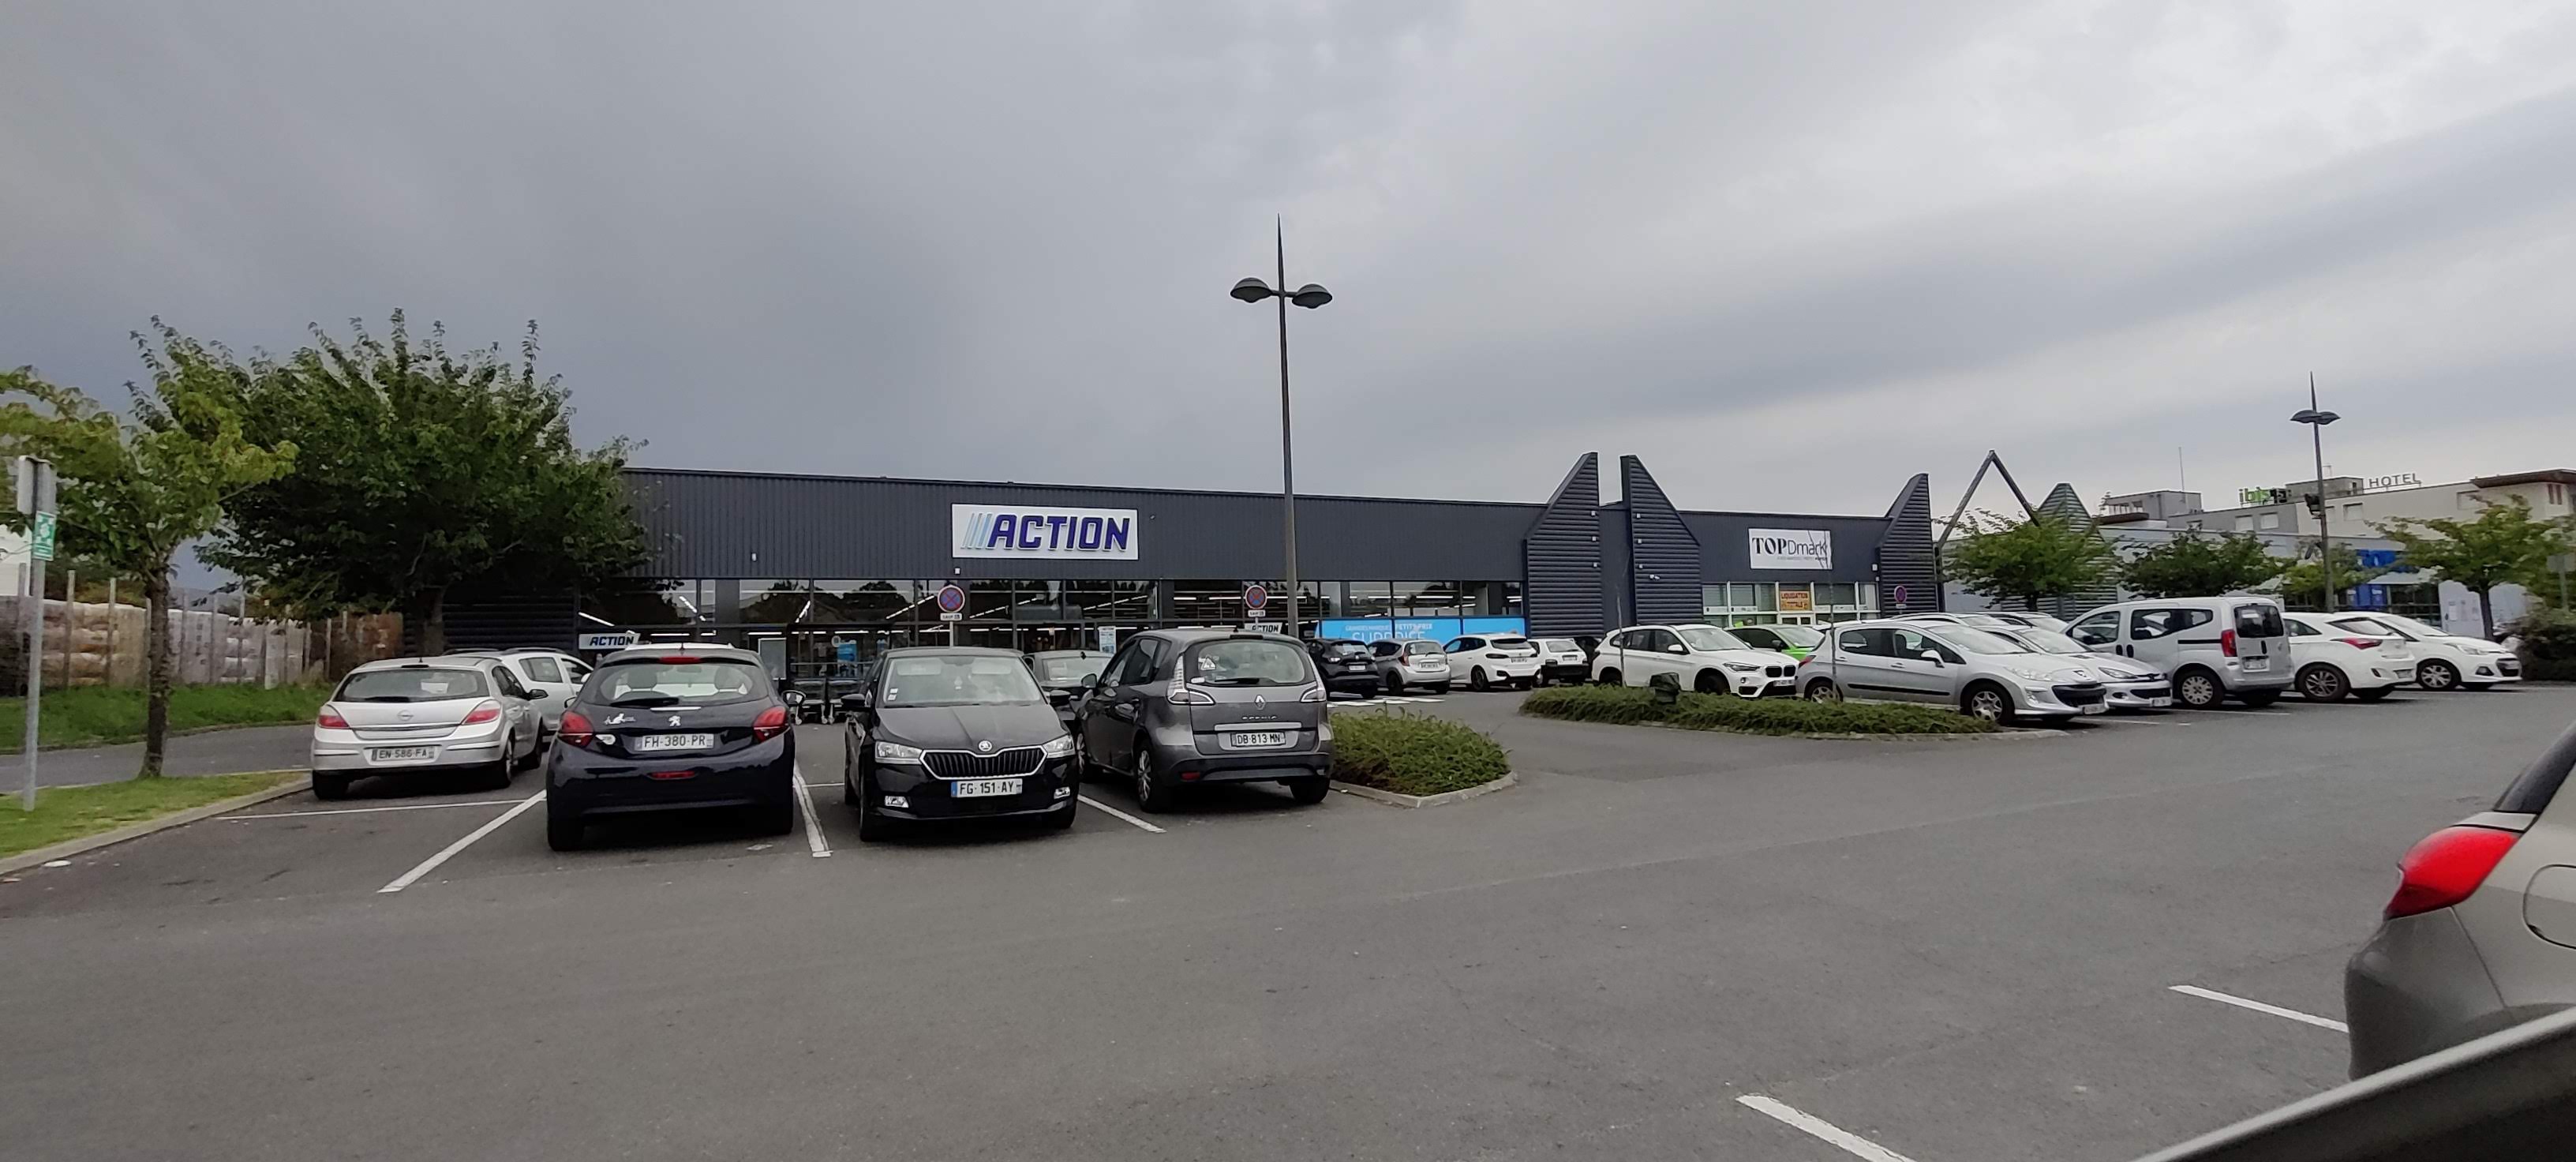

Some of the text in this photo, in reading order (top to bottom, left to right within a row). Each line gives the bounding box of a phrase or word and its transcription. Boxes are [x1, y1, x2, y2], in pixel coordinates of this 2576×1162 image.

[2368, 473, 2421, 488] HOTEL
[987, 514, 1130, 550] ACTION
[589, 635, 635, 646] ACTION
